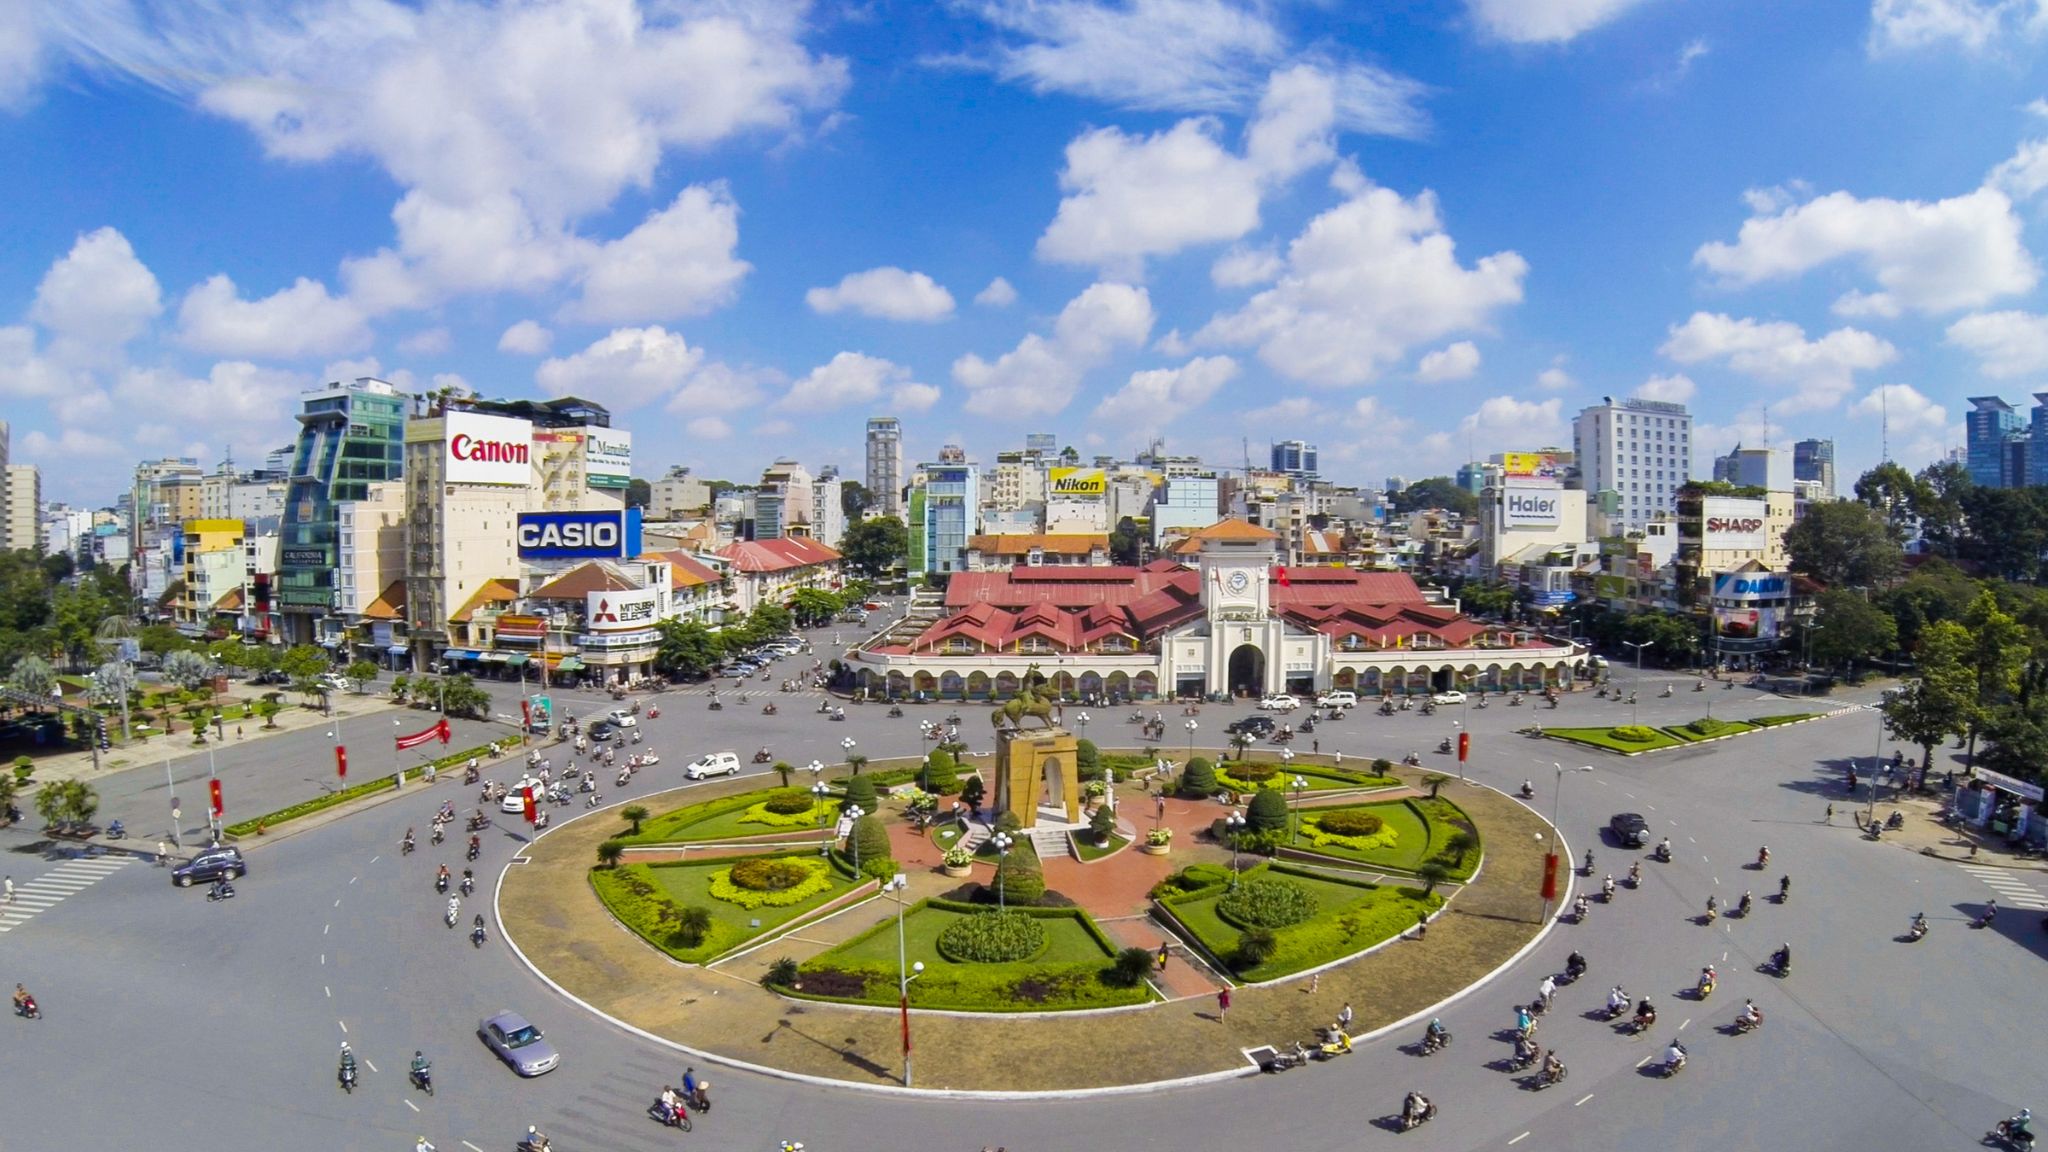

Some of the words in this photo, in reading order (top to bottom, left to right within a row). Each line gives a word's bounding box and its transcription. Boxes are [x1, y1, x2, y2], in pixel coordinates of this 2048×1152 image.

[451, 433, 529, 464] Canon
[1055, 478, 1099, 491] Nikon
[1509, 495, 1555, 512] Haier
[1706, 517, 1763, 534] SHARP
[518, 522, 618, 547] CASIO
